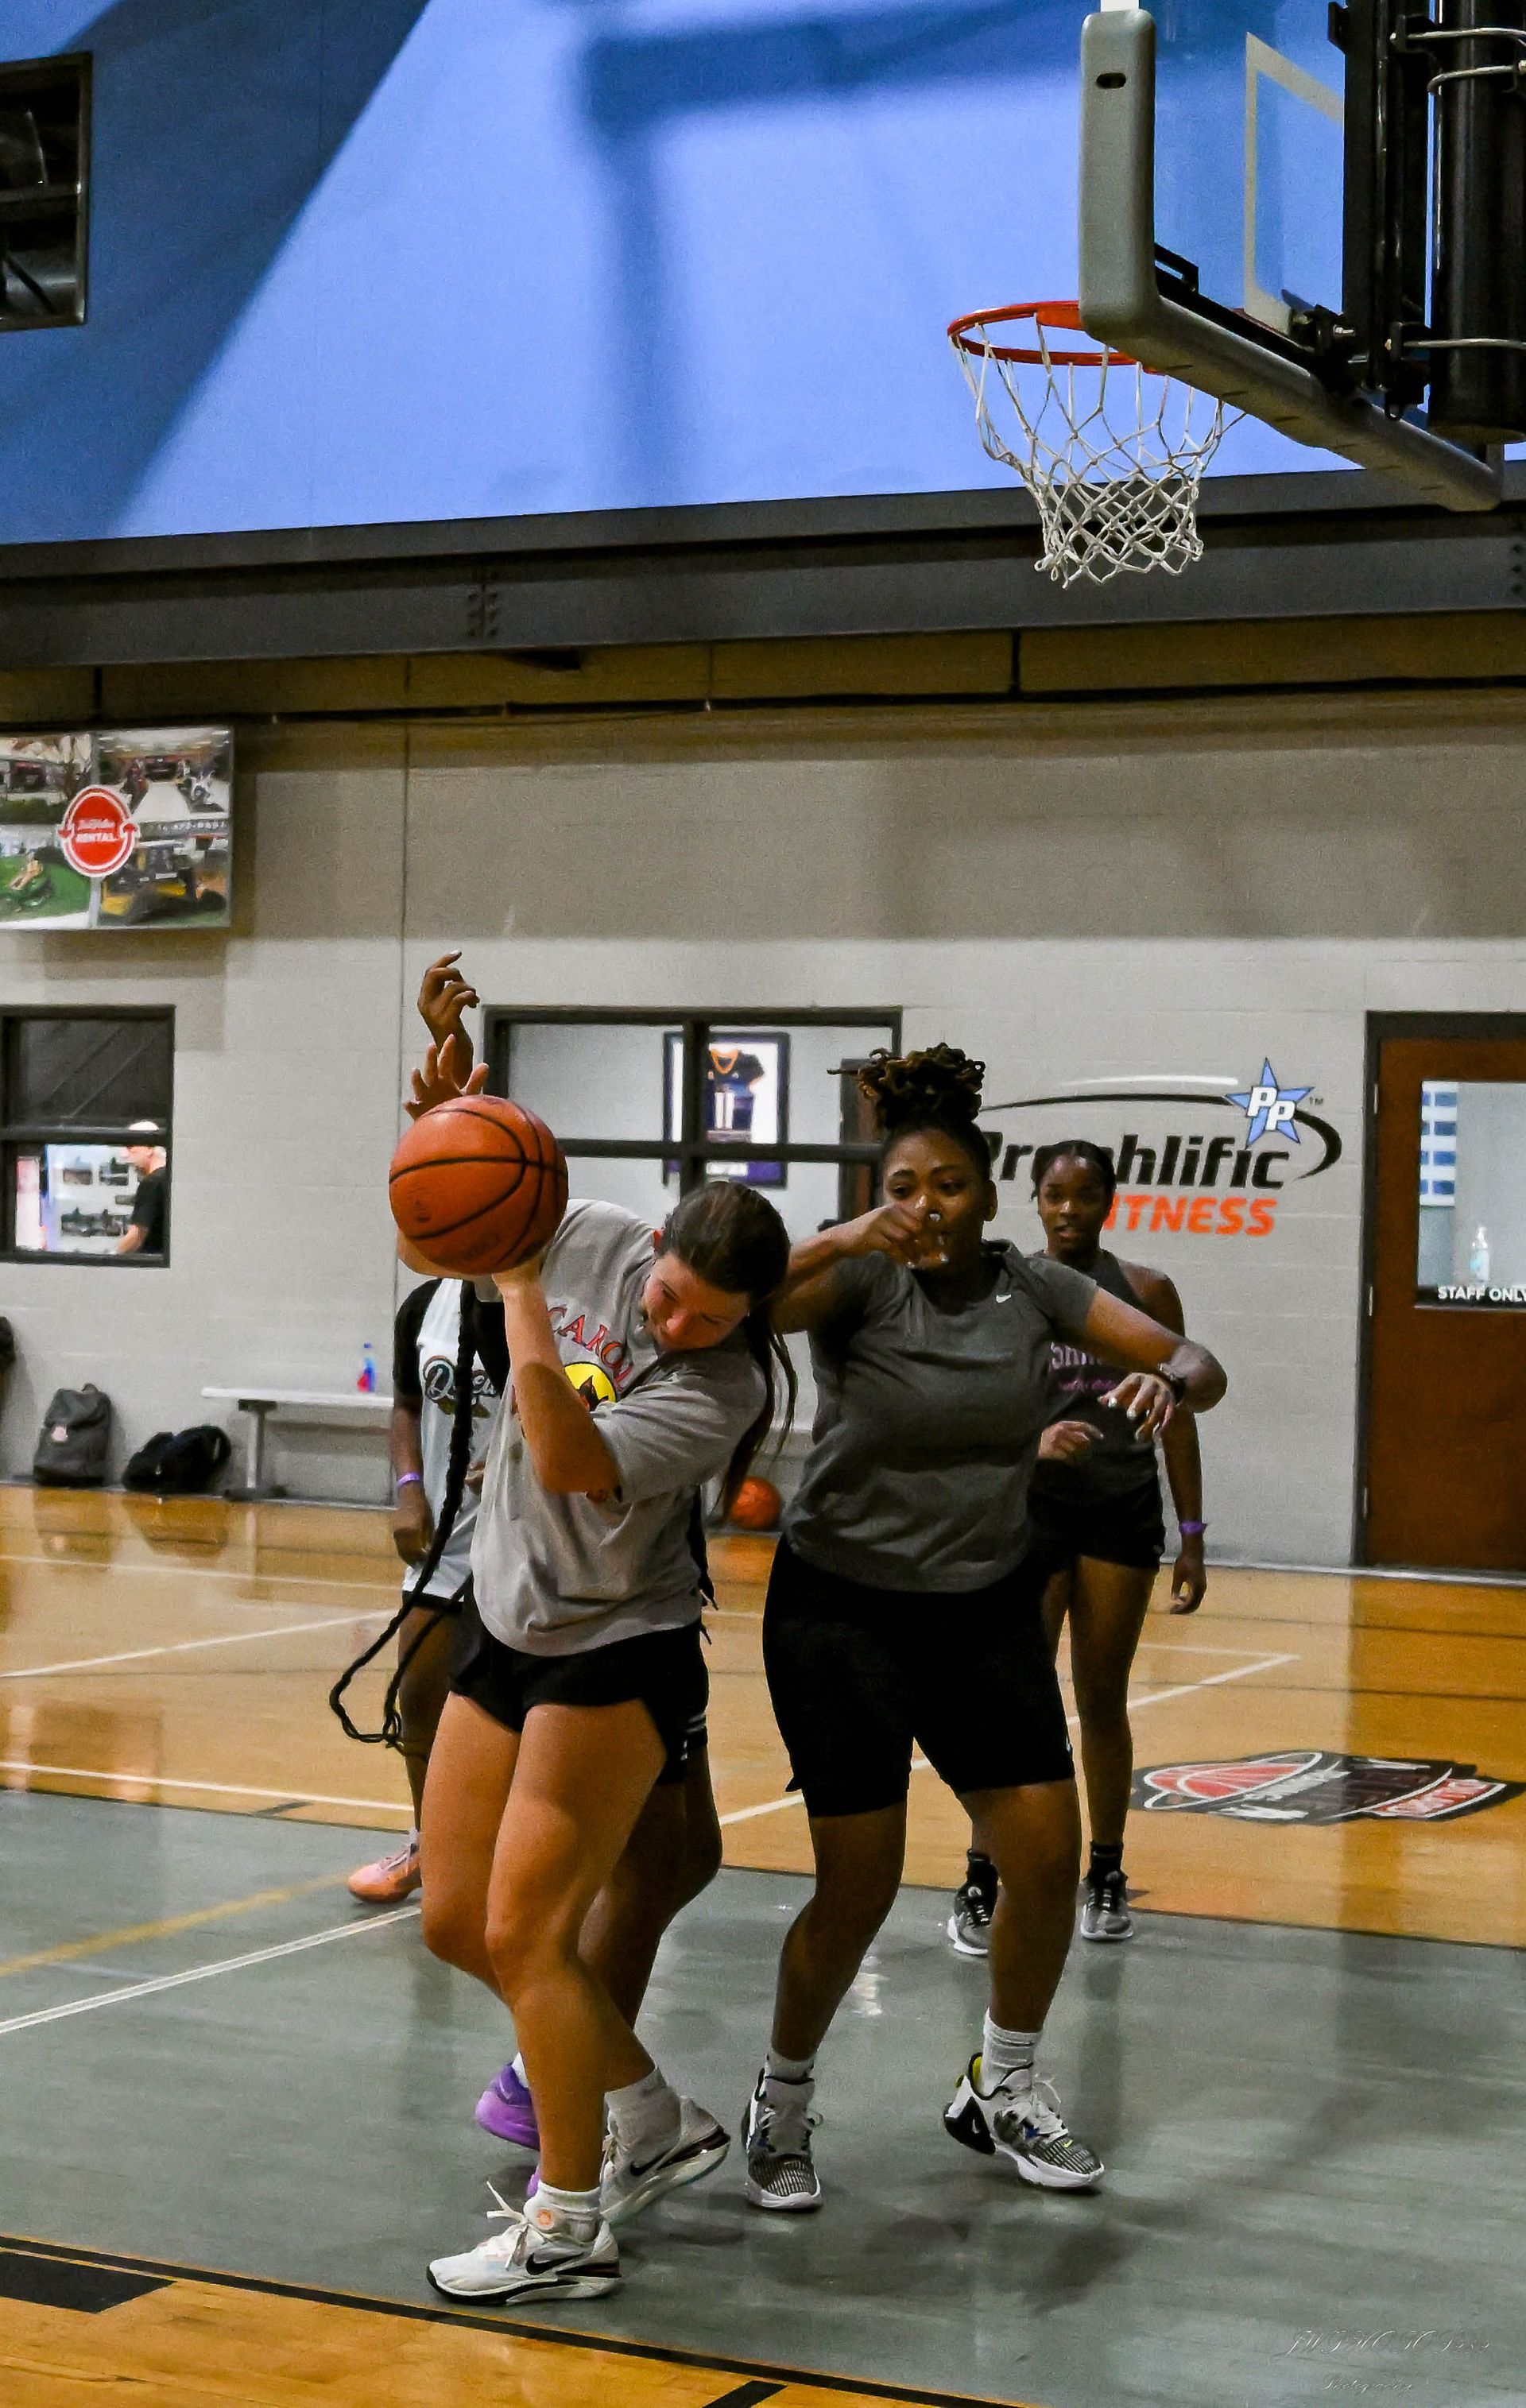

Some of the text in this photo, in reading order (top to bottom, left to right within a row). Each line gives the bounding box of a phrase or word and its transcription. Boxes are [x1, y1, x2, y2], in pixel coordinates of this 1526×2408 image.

[981, 1132, 1291, 1190] rhlific
[1102, 1192, 1277, 1237] ITNESS
[1437, 1285, 1485, 1300] STAFF
